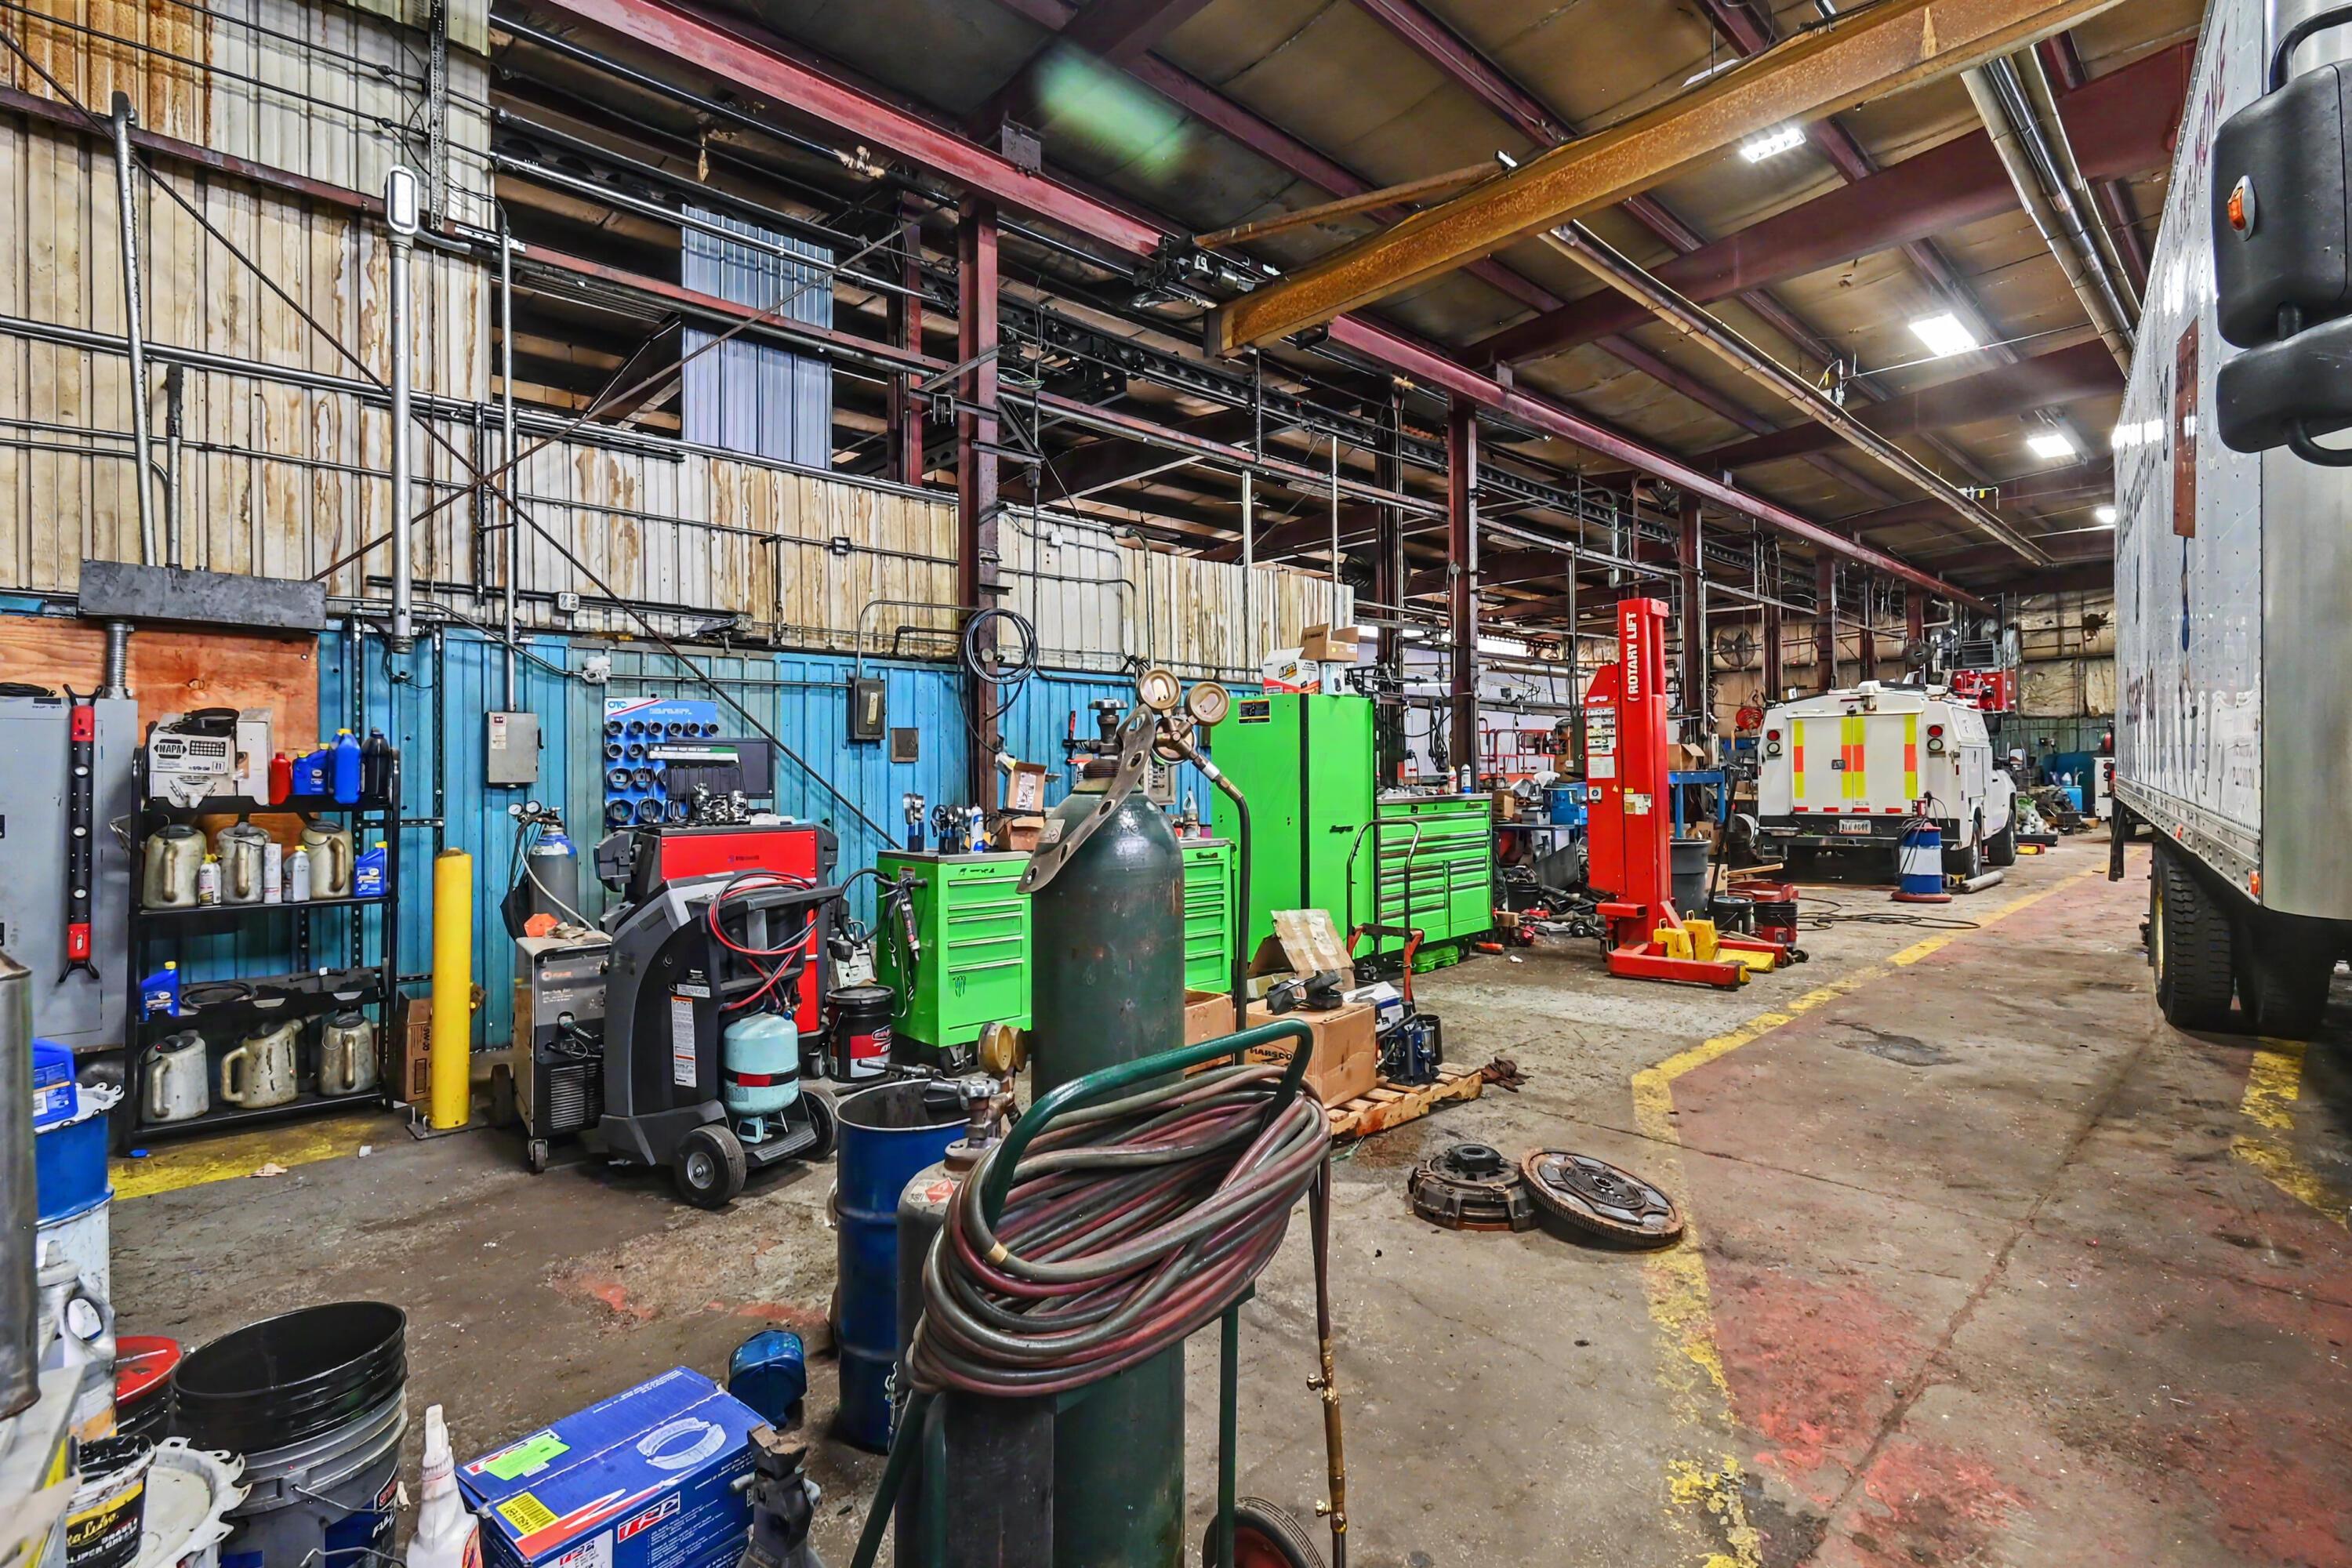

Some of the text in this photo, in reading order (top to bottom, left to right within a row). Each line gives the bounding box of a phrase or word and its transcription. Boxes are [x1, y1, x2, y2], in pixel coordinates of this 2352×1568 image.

[1626, 612, 1639, 695] ROTARY LIFT
[159, 744, 182, 753] NAPA
